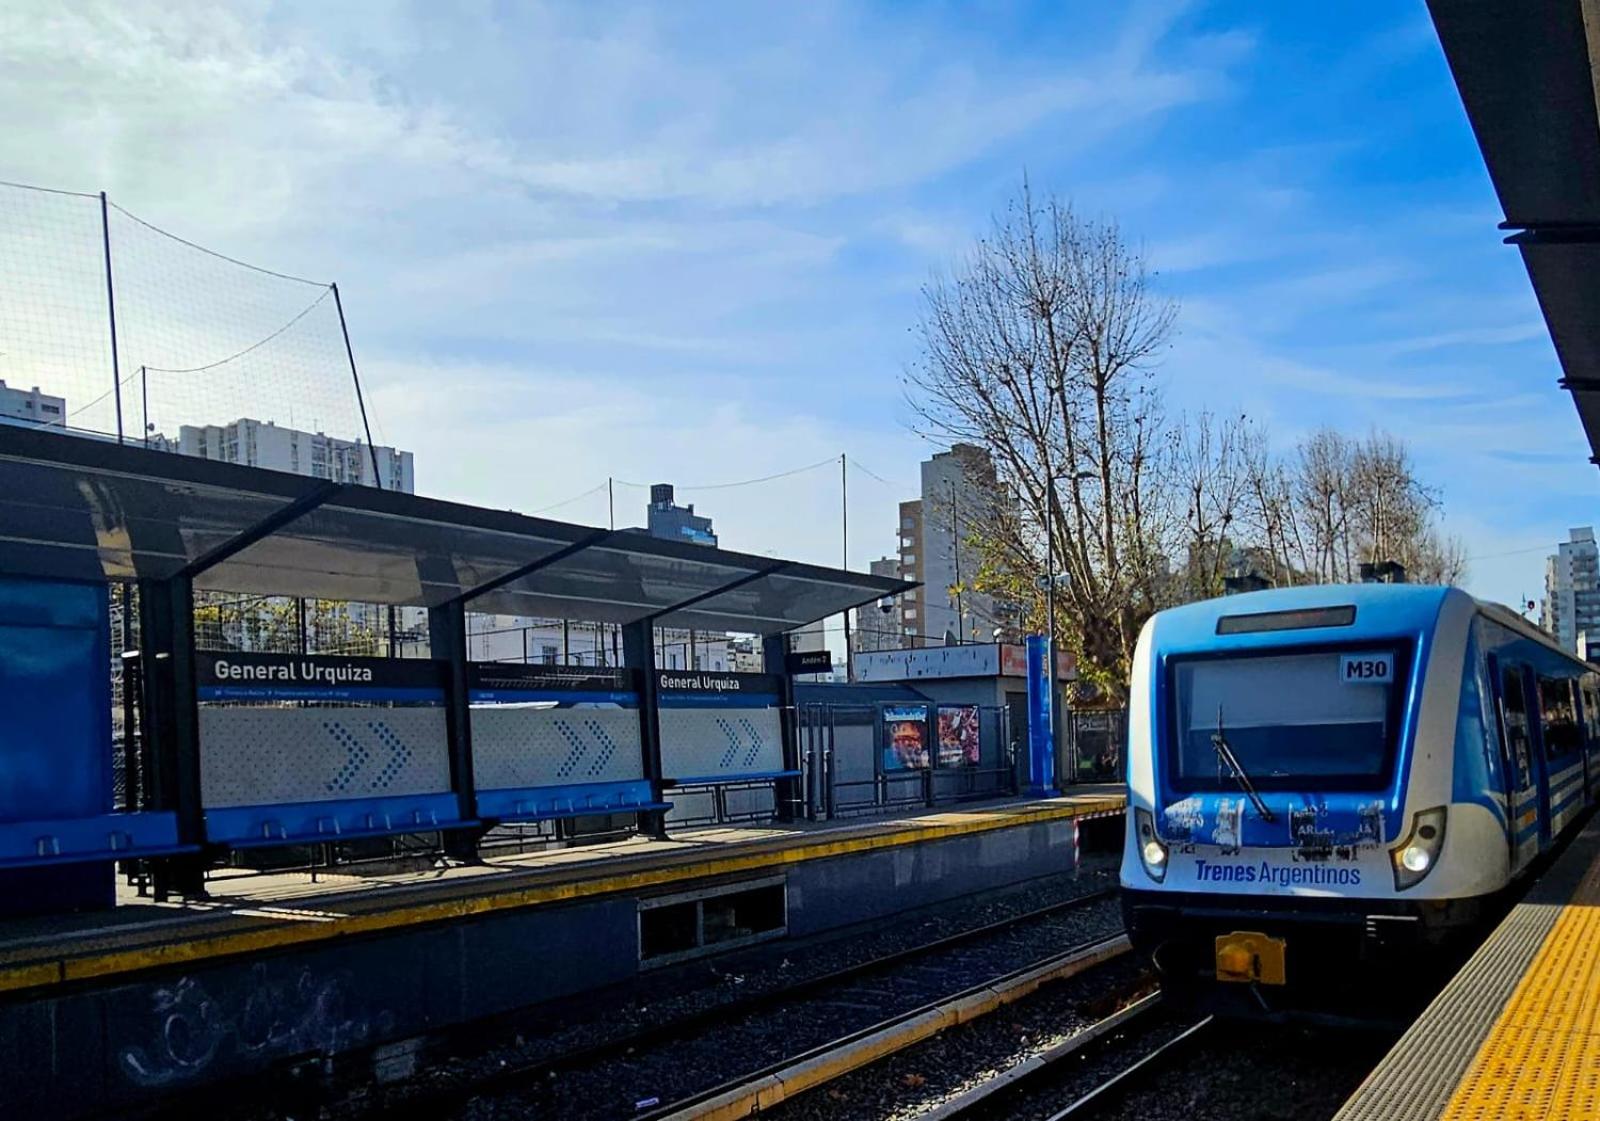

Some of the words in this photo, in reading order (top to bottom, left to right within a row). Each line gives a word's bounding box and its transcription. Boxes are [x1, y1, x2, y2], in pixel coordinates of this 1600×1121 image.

[214, 660, 297, 680] General
[300, 662, 373, 685] Urquiza
[1346, 660, 1387, 679] M30
[660, 674, 702, 689] General
[703, 675, 740, 693] Urquiza
[1195, 860, 1256, 883] Trenes
[1258, 861, 1361, 888] Argentinos
